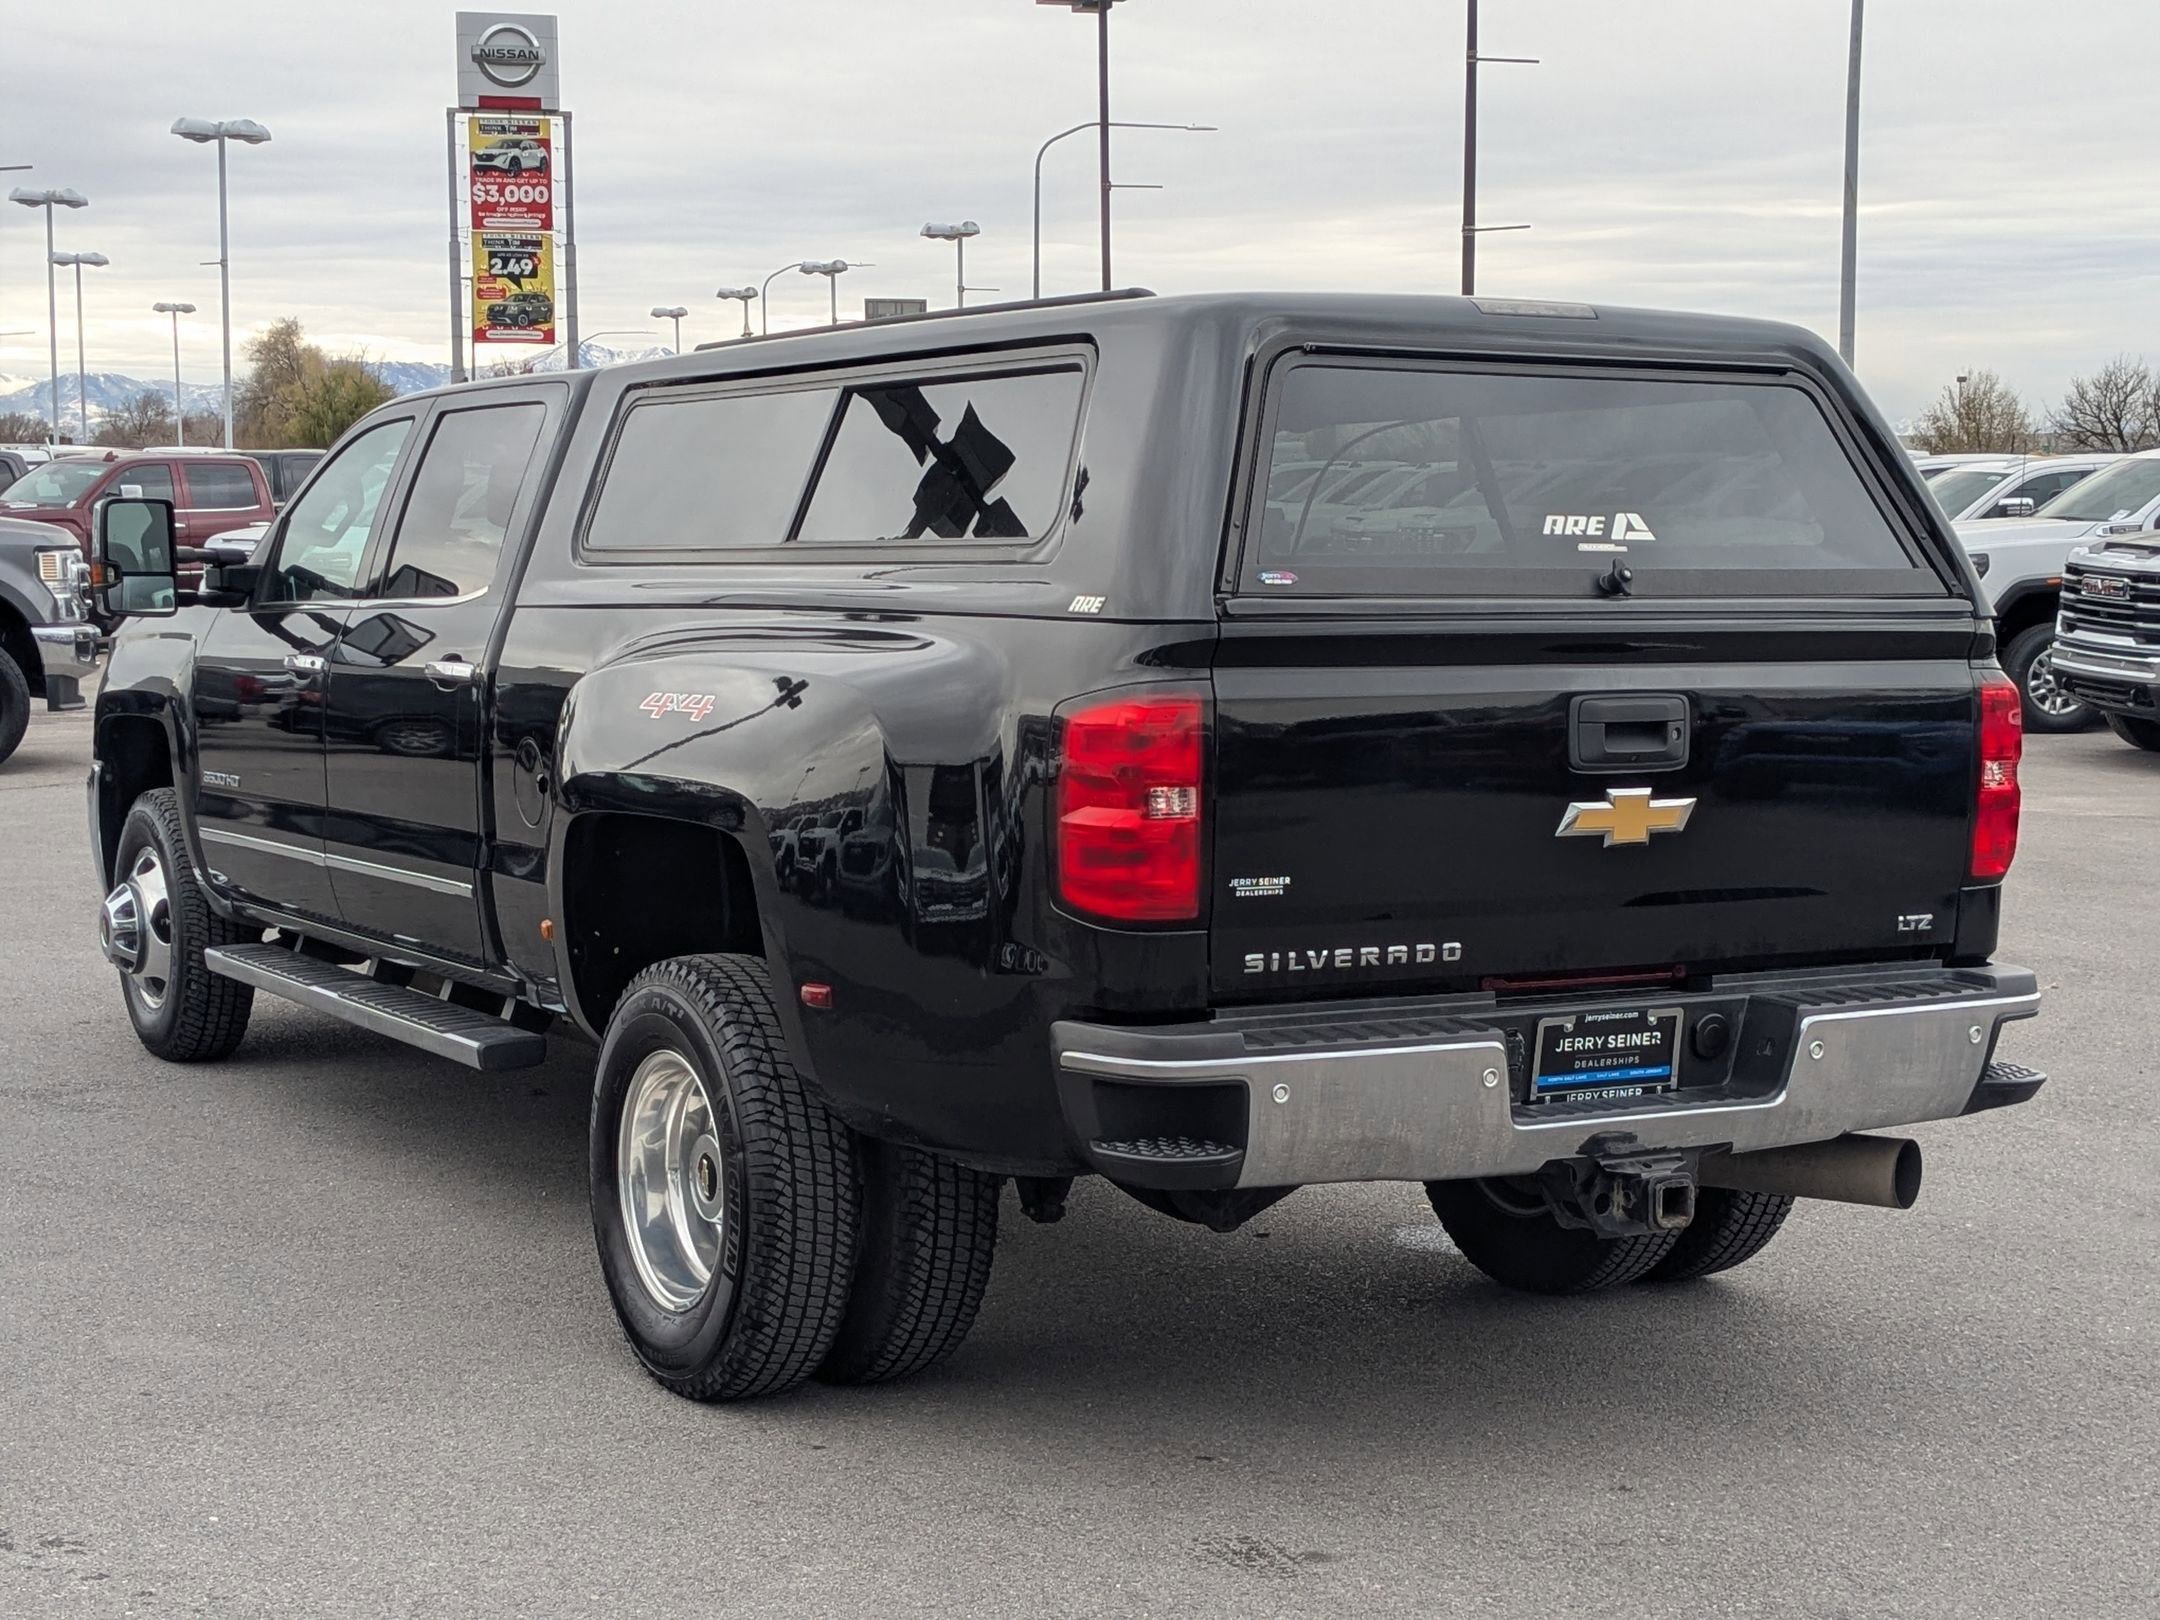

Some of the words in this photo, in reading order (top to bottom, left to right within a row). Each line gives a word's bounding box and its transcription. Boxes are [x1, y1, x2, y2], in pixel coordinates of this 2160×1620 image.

[480, 48, 539, 60] NISSAN
[472, 182, 549, 206] $3,000
[490, 257, 533, 275] 2.49
[1542, 515, 1606, 535] ARE
[1068, 596, 1106, 613] ARE
[1229, 878, 1257, 887] JERRY
[1258, 876, 1291, 886] SEINER
[1236, 888, 1284, 897] DEALERSHIPS
[1898, 914, 1933, 931] LTZ
[1243, 942, 1462, 973] SILVERADO
[1584, 1011, 1639, 1023] jerryseiner.com
[1555, 1035, 1605, 1052] JERRY
[1607, 1031, 1661, 1049] SEINER
[1574, 1056, 1640, 1069] DEALERSHIPS
